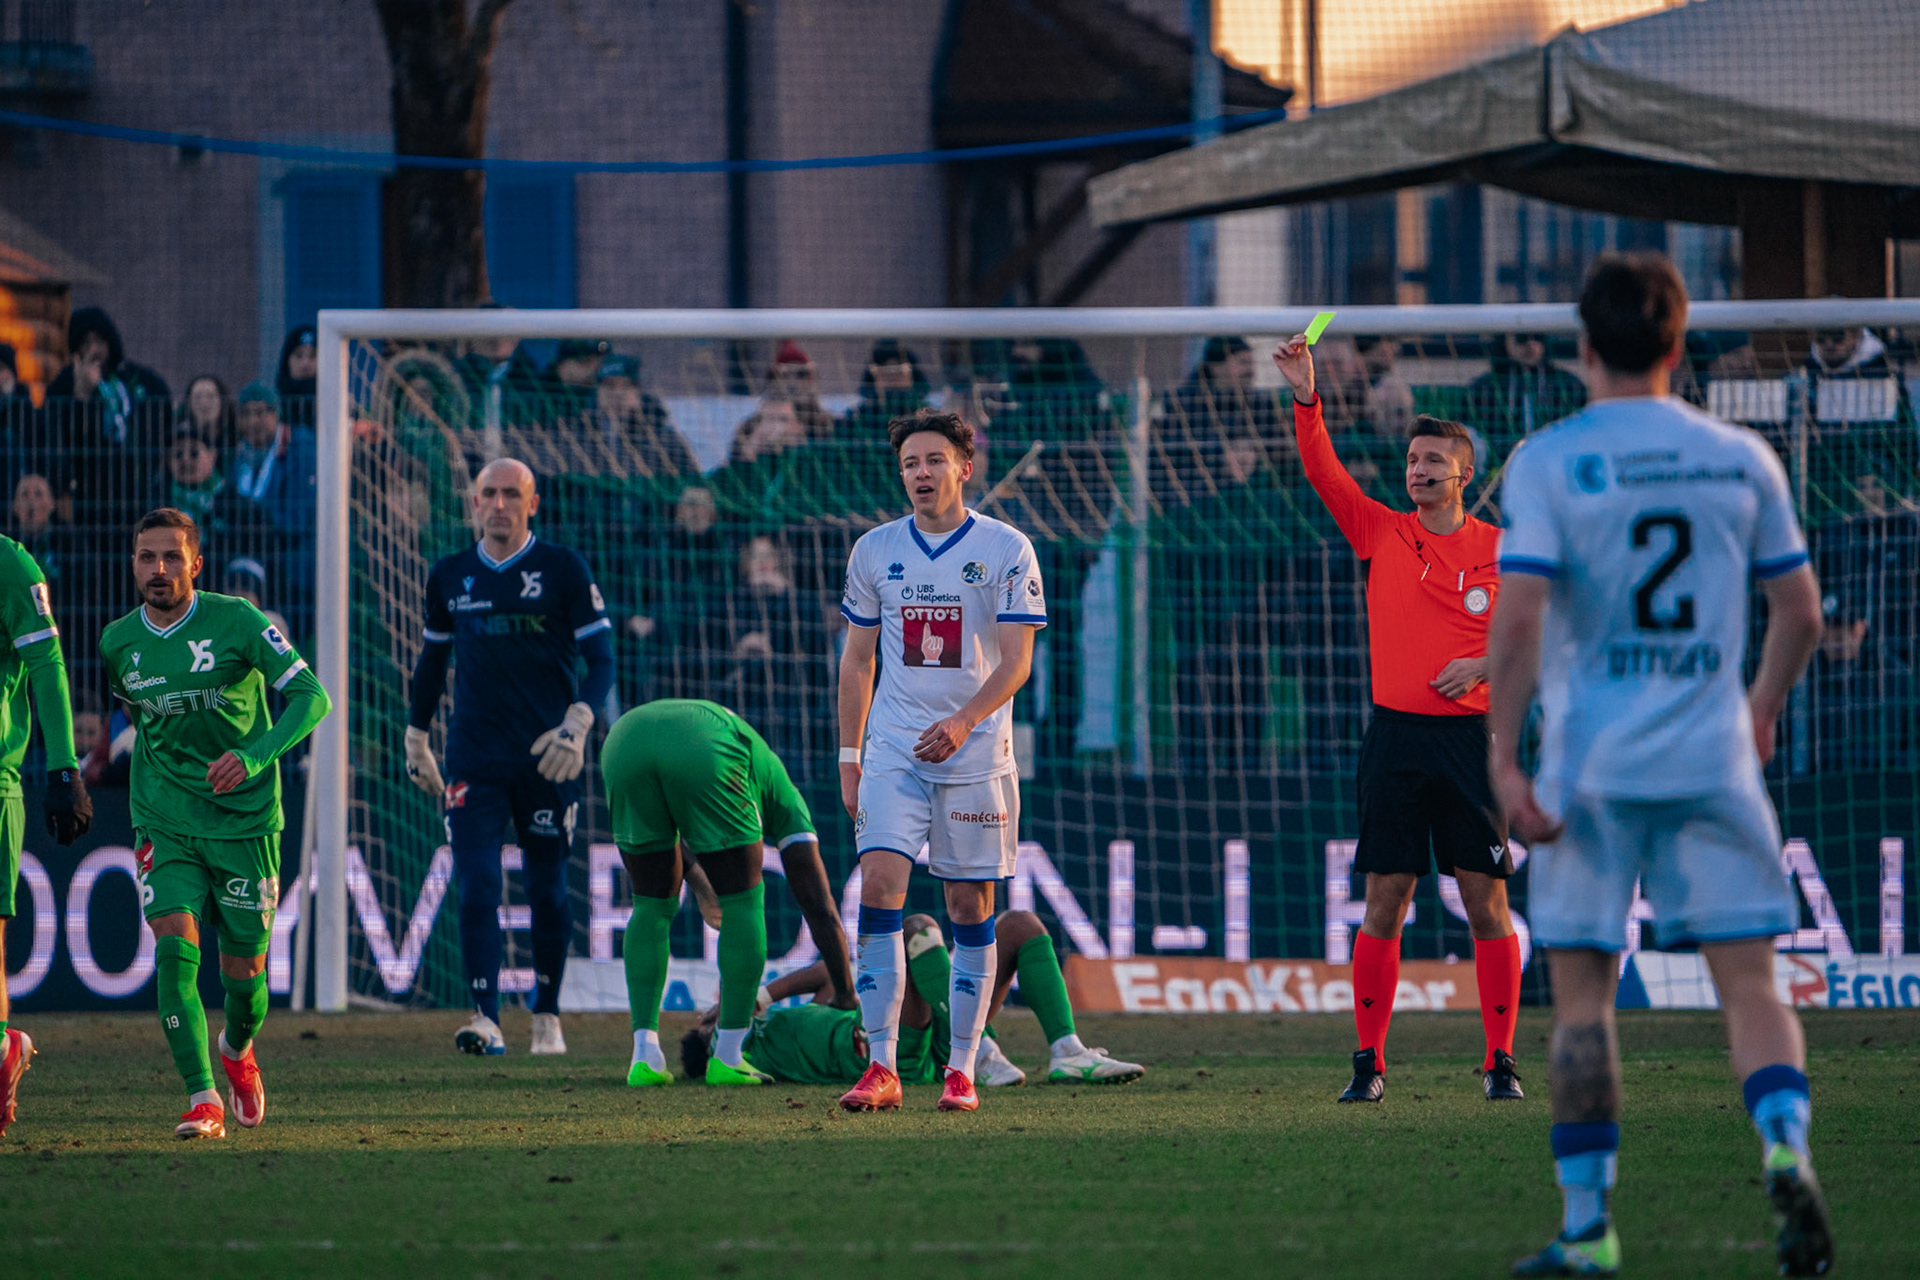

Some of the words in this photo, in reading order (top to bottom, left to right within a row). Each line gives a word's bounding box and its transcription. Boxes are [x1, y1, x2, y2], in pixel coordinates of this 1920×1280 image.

[1631, 509, 1695, 631] 2
[916, 584, 935, 593] UBS
[916, 593, 961, 604] Helpetica
[903, 607, 960, 622] OTTO'S
[166, 1015, 180, 1029] 19
